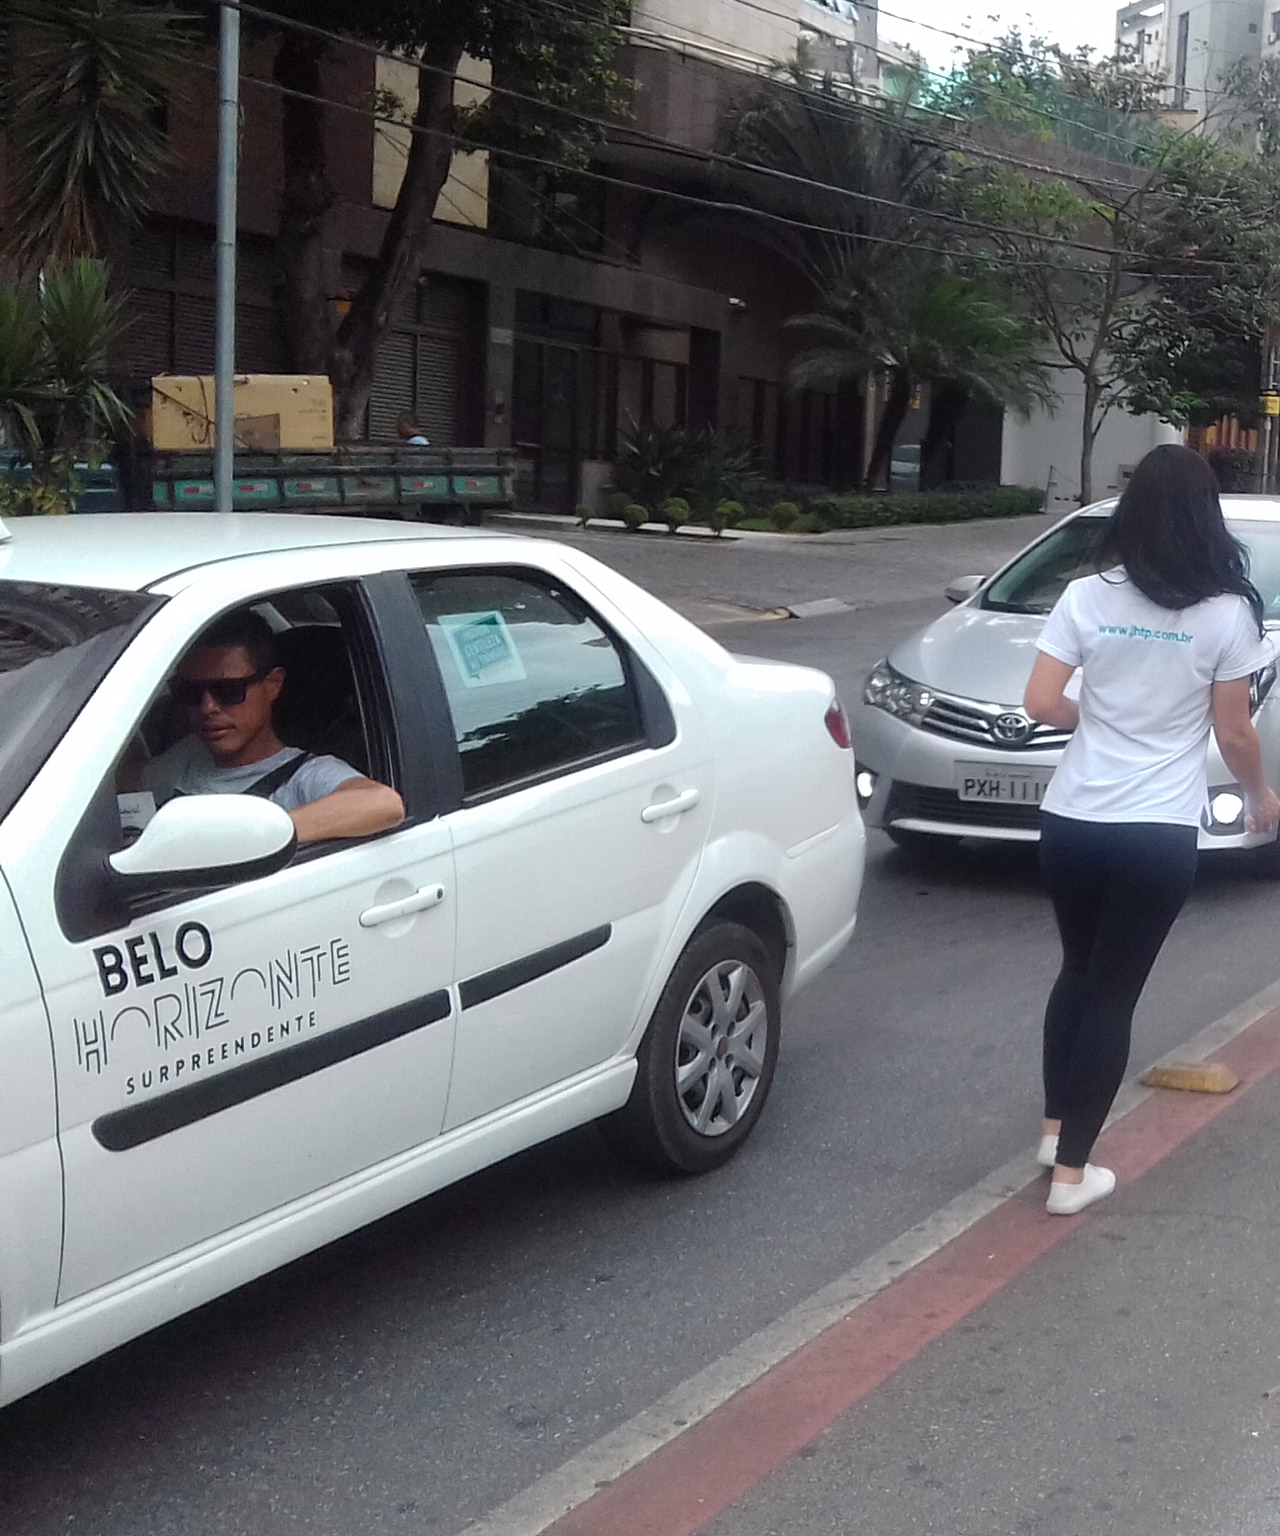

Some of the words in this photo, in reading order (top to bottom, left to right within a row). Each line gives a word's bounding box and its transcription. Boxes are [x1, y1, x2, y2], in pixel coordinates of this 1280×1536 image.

[1098, 624, 1194, 643] www.jhtp.com.br
[92, 921, 213, 997] BELO
[73, 938, 351, 1075] HORIZONTE
[125, 1010, 317, 1095] SURPREENDENTE
